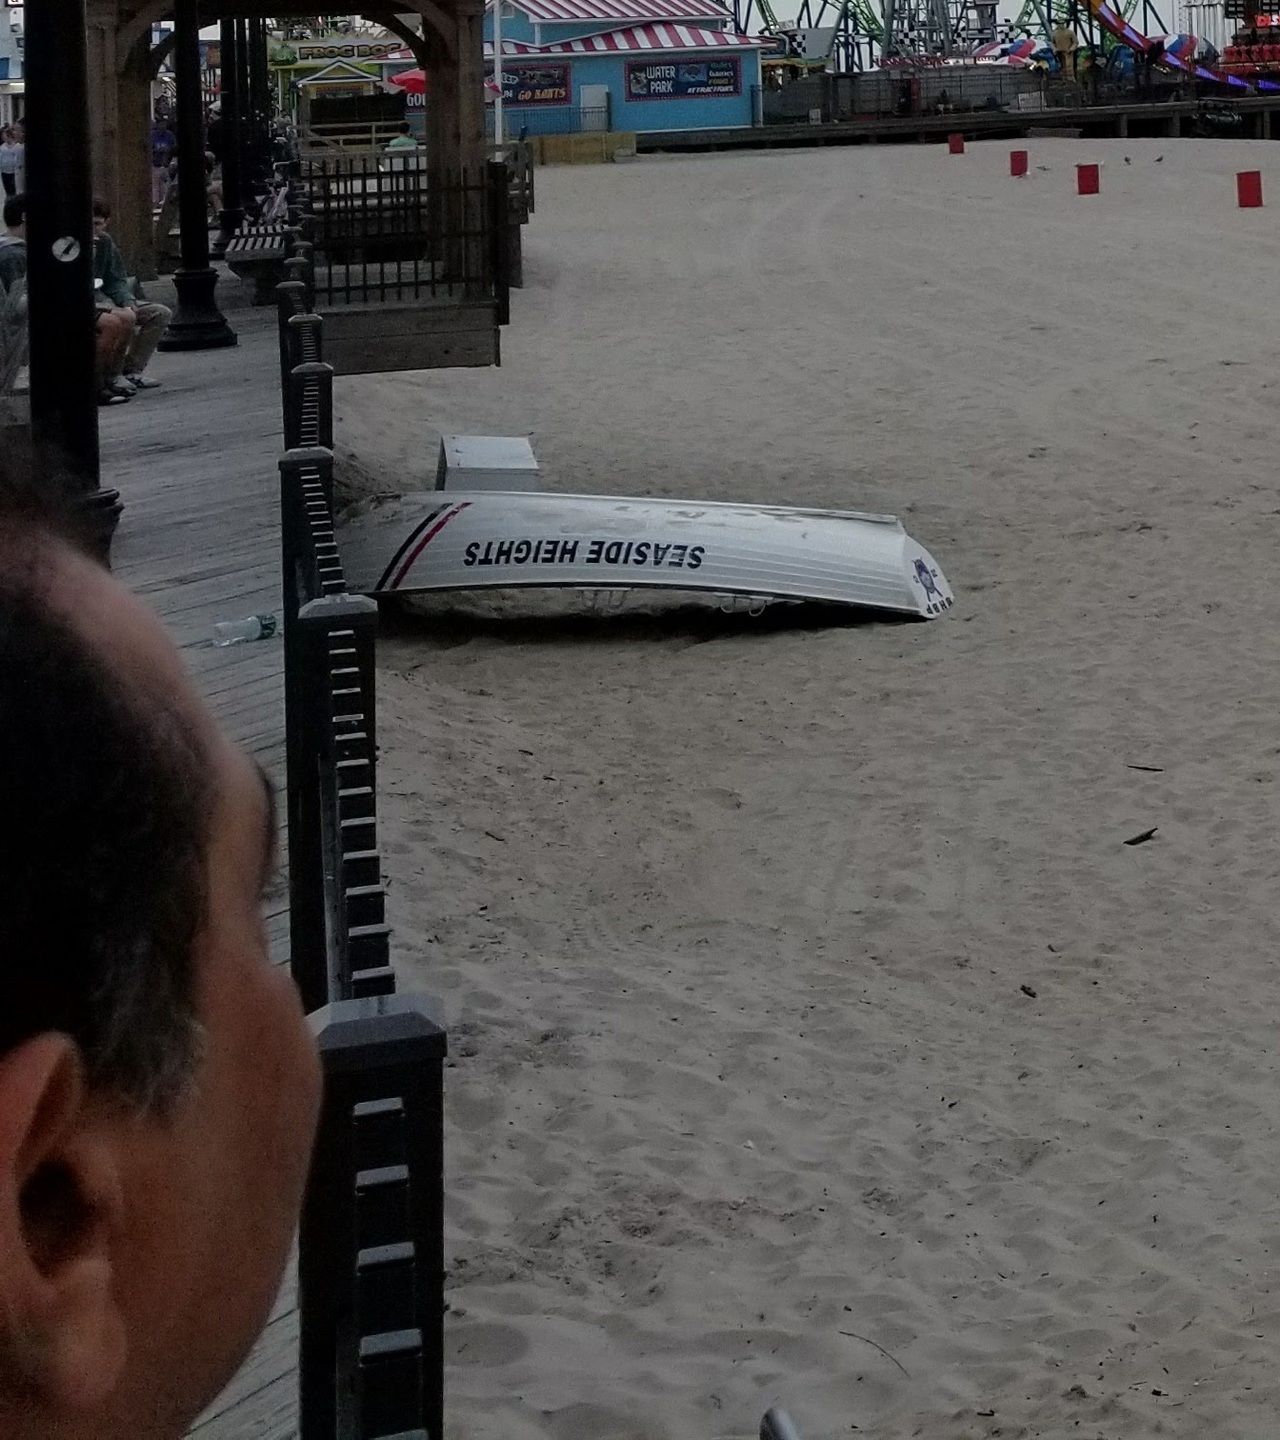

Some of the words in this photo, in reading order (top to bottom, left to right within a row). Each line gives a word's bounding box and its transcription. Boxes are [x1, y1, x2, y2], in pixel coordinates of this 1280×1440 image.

[299, 44, 355, 59] FROG
[646, 65, 676, 79] WATER
[650, 80, 673, 94] PARK
[463, 539, 580, 567] HEIGHTS
[585, 540, 706, 569] SEASIDE
